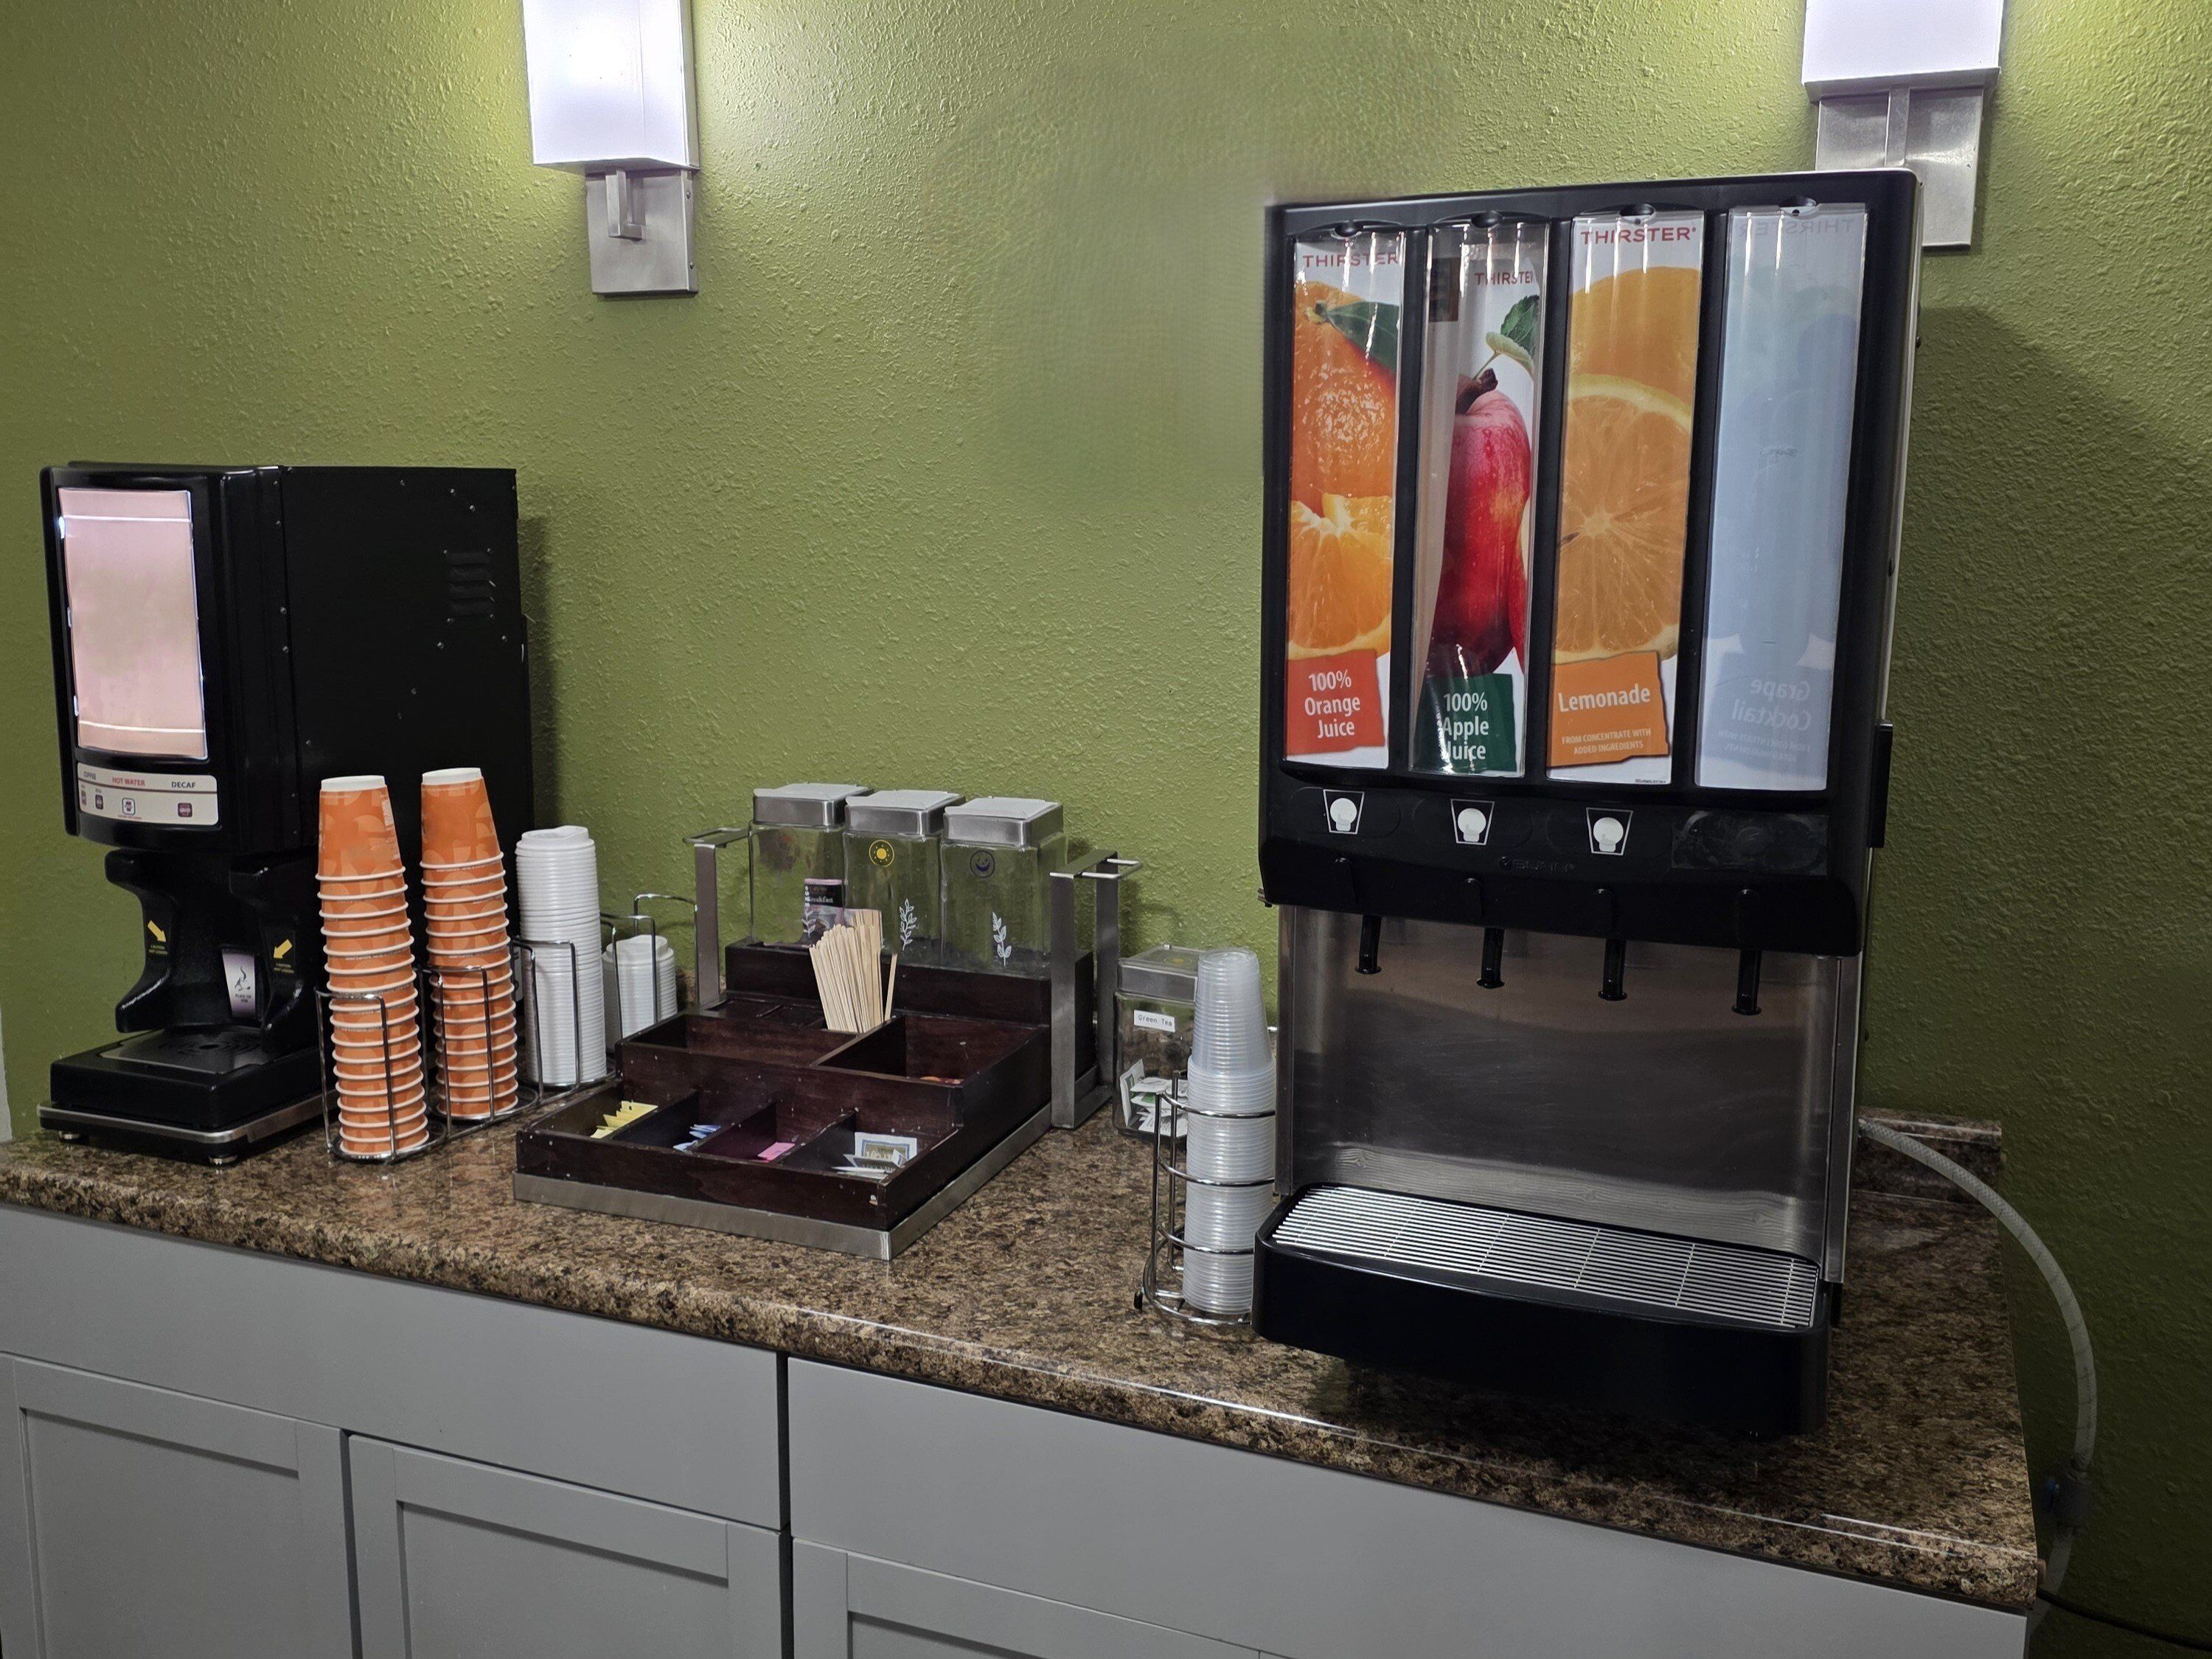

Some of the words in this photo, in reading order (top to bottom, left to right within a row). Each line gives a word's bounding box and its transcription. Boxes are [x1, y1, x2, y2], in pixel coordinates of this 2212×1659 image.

[1580, 227, 1691, 245] THIRSTER
[1309, 669, 1352, 692] 100%
[1304, 696, 1360, 717] Orange
[1443, 692, 1488, 712] 100%
[1558, 683, 1651, 712] Lemonade
[1318, 718, 1355, 739] Juice
[1442, 715, 1489, 741] Apple
[1562, 736, 1582, 745] FROM
[1582, 730, 1631, 742] CONCENTRATE
[1632, 728, 1651, 737] WITH
[1445, 740, 1486, 760] Juice
[1573, 745, 1597, 755] ADDED
[1599, 740, 1644, 752] INGREDIENTS
[124, 778, 145, 787] WATER
[1138, 1014, 1158, 1024] Green
[1161, 1018, 1172, 1027] Tea
